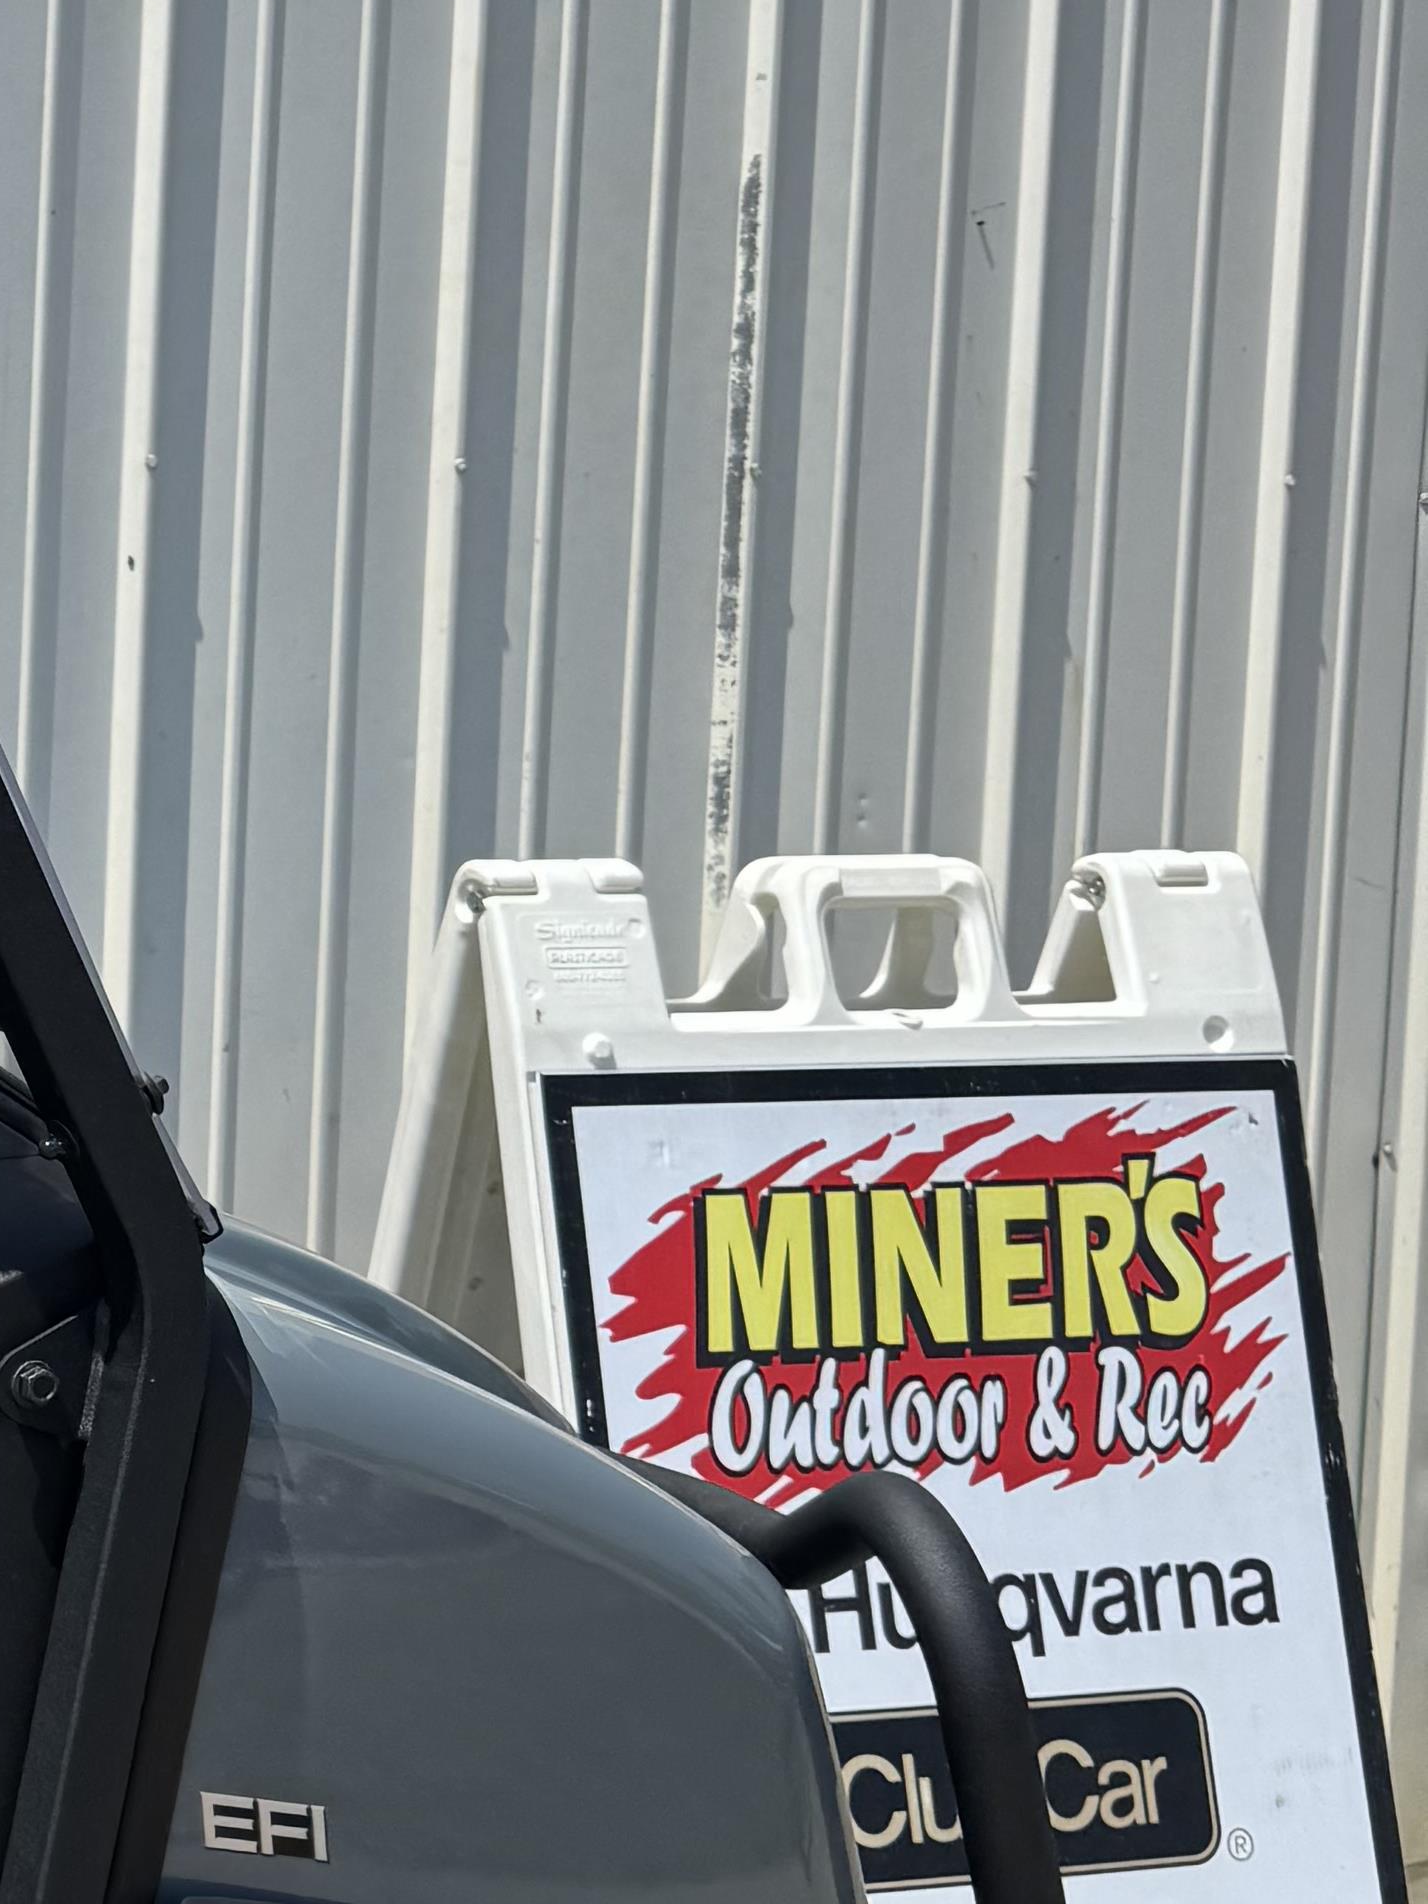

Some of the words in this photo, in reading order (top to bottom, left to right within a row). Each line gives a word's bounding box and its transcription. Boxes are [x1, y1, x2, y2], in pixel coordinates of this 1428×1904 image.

[697, 1154, 1209, 1362] MINER'S
[711, 1348, 1005, 1475] Outdoor
[1027, 1345, 1077, 1461] &
[1096, 1346, 1212, 1454] Rec
[807, 1557, 1280, 1657] Huqvarna
[199, 1791, 329, 1863] EFI
[842, 1753, 962, 1849] Clu
[1038, 1739, 1167, 1832] Car
